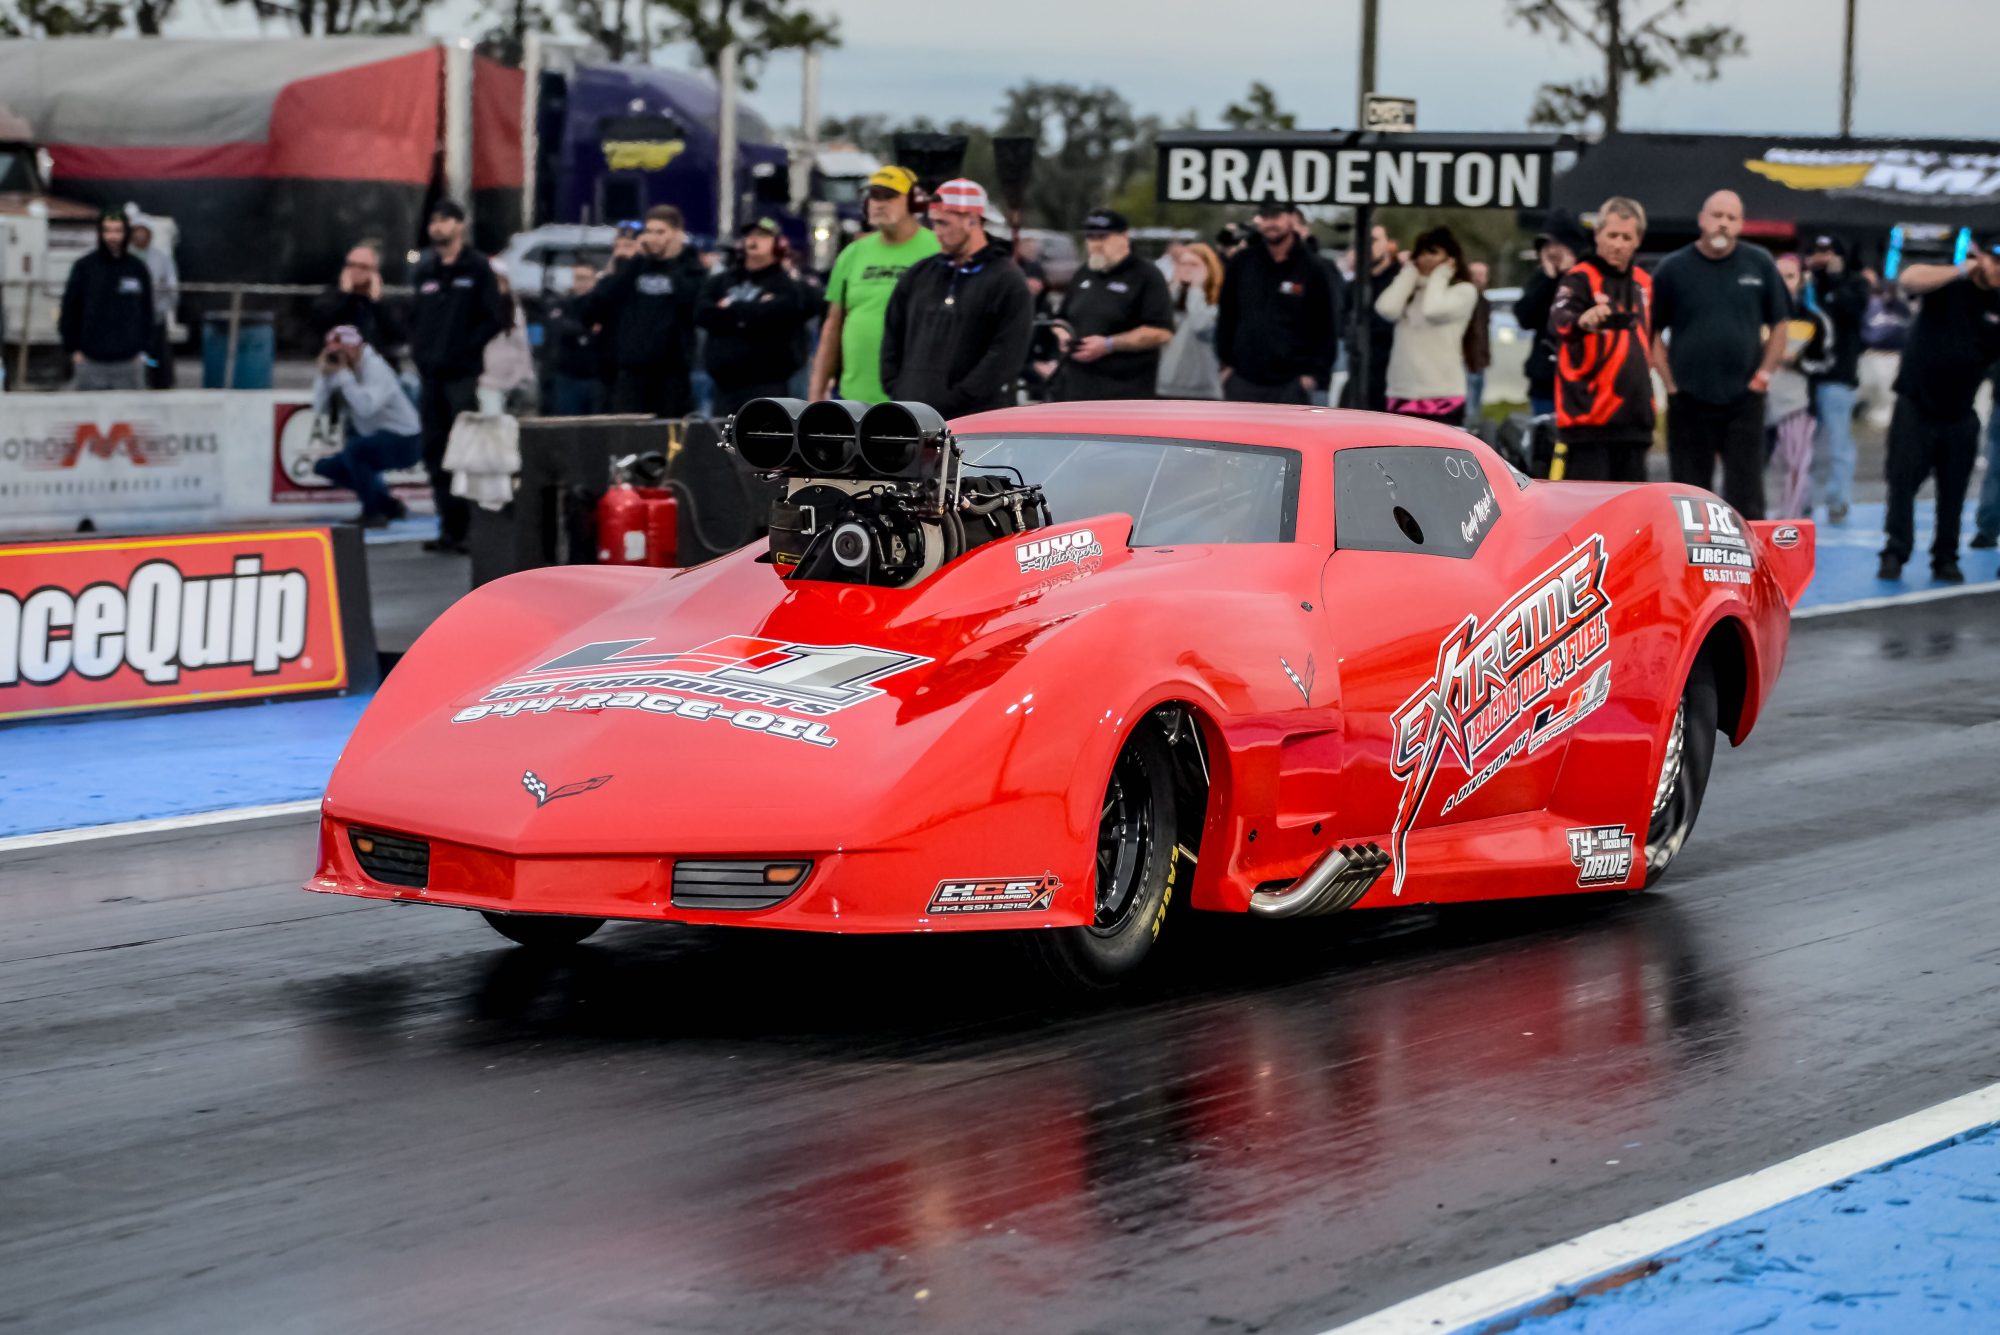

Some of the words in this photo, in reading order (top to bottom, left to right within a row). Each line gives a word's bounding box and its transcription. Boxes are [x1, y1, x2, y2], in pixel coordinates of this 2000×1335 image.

[1167, 148, 1540, 208] BRADENTON
[1016, 529, 1095, 564] WYO
[1037, 541, 1103, 572] Motorsports
[1692, 547, 1752, 567] LJRC1.com
[1391, 534, 1611, 785] EXTREME
[480, 683, 557, 702] OIL
[559, 676, 842, 716] PRODUCTS
[1472, 682, 1520, 749] RACING
[1520, 661, 1547, 706] OIL
[1549, 646, 1564, 684] &
[1565, 614, 1608, 674] FUEL
[452, 691, 838, 747] 844-RACE-OIL
[1442, 795, 1454, 814] A
[1457, 751, 1511, 801] DIVISION
[1513, 731, 1529, 754] OF
[1569, 831, 1598, 858] TY-
[1581, 853, 1628, 879] DRIVE
[930, 902, 1029, 913] 314.691.3215
[939, 894, 959, 902] HIGH
[960, 894, 992, 902] CALIBER
[993, 893, 1031, 901] GRAPHICS
[1151, 844, 1180, 945] EAGLE
